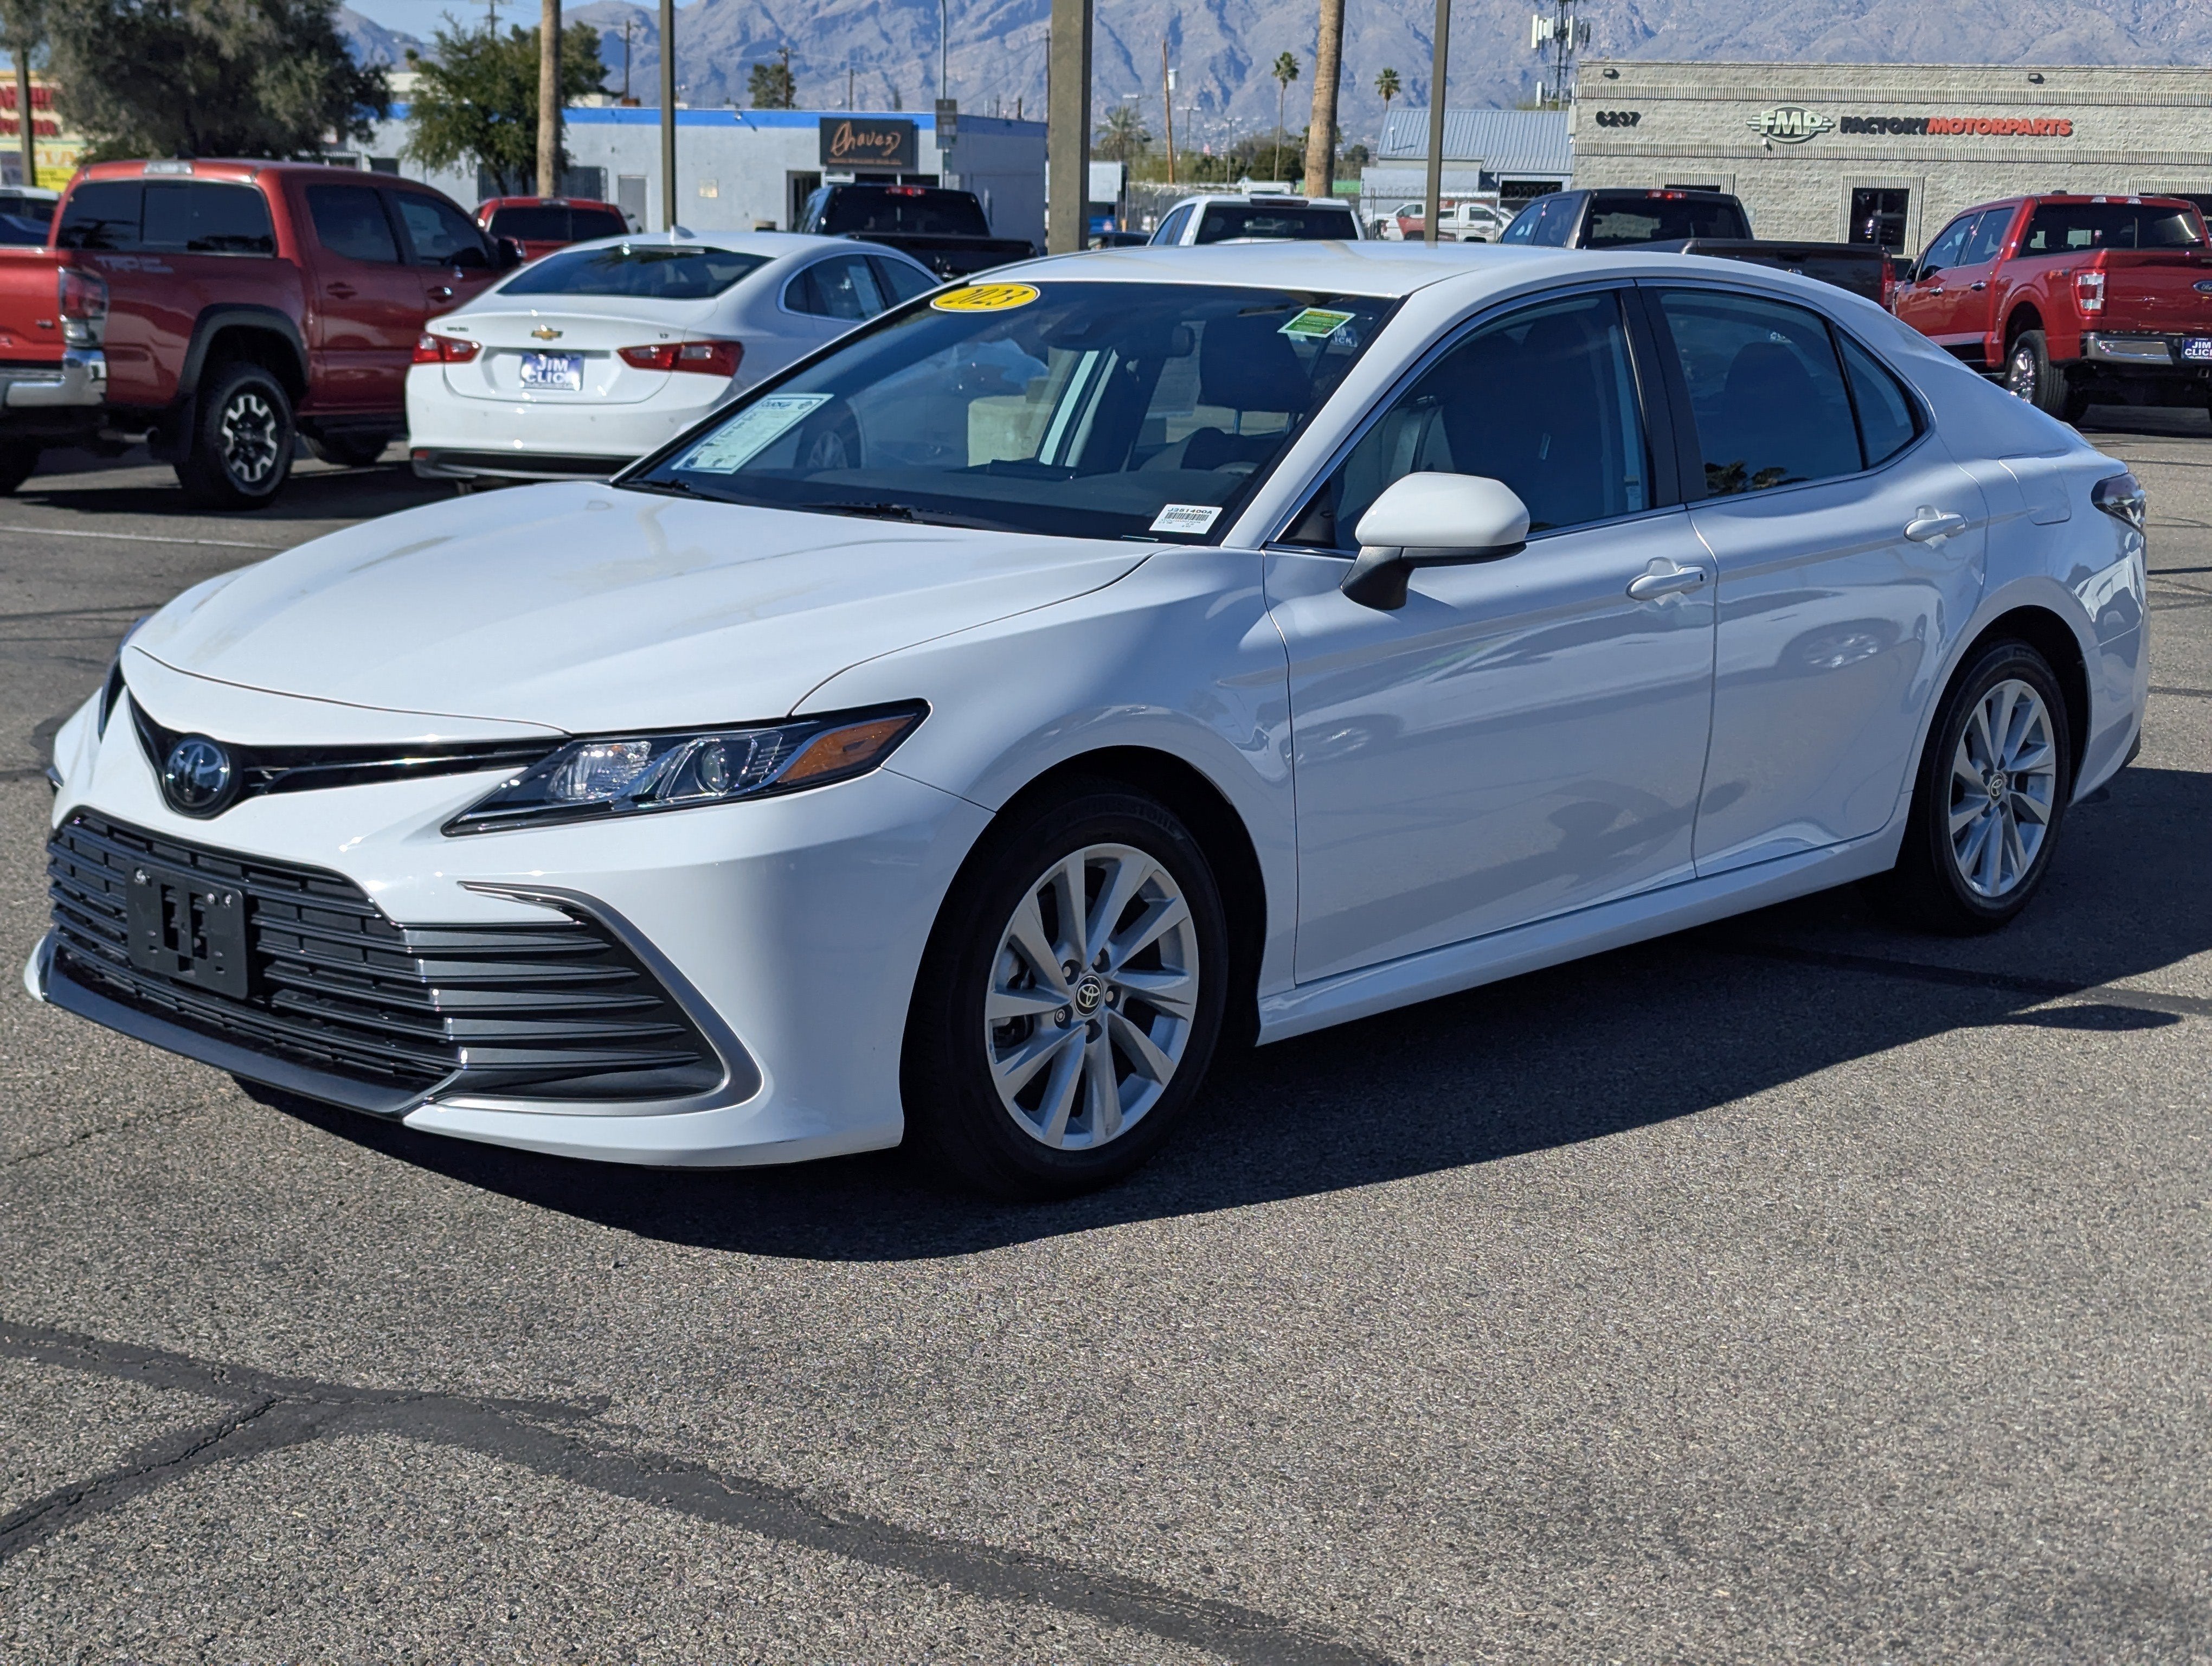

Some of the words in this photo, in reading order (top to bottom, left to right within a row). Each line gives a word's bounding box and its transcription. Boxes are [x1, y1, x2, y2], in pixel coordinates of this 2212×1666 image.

[1760, 111, 1823, 136] FMP
[941, 287, 1030, 306] 2023
[536, 357, 568, 372] JIM
[526, 371, 578, 384] CLIC
